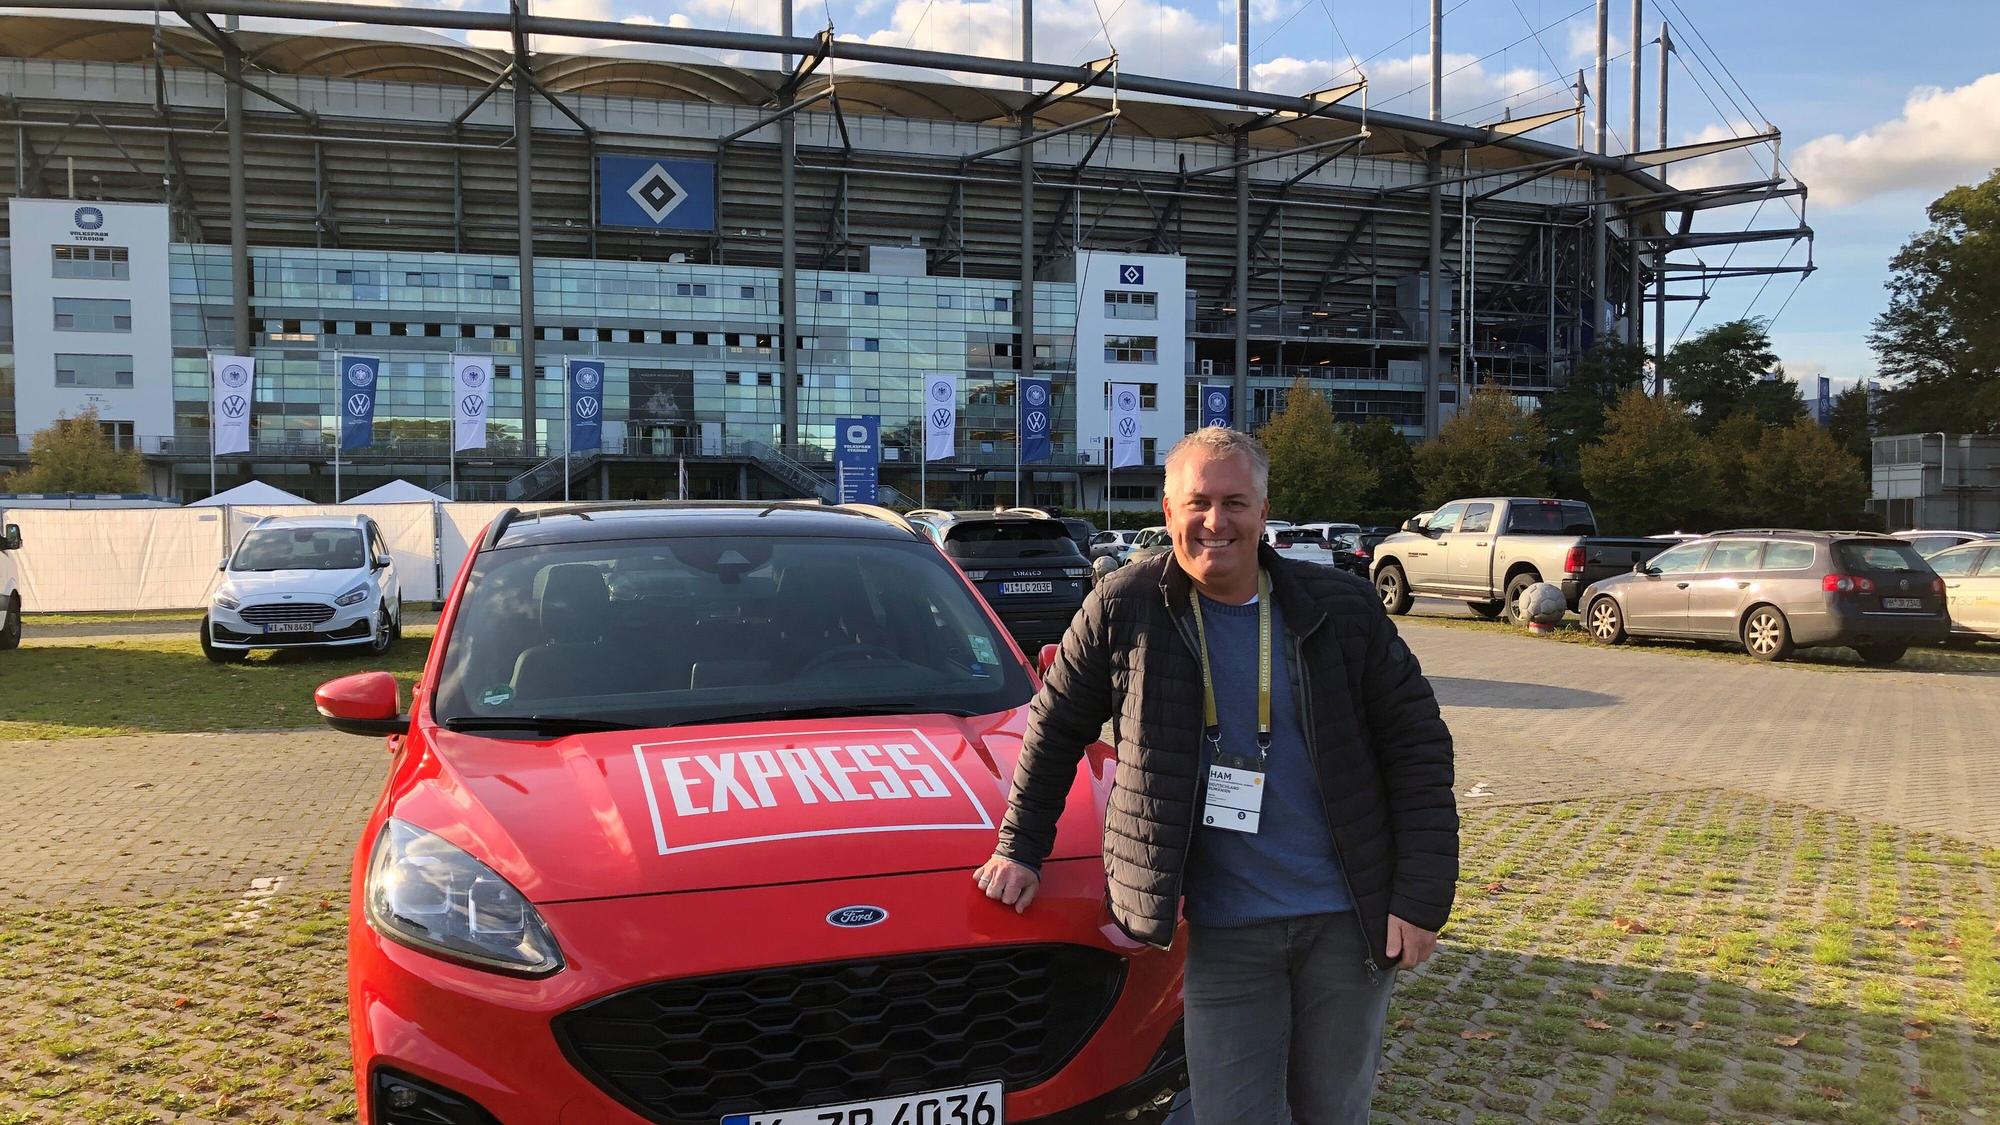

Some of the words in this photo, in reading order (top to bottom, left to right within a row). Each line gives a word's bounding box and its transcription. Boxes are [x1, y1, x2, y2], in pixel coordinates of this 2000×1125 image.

[661, 744, 952, 817] EXPRESS
[1210, 770, 1231, 780] HAM
[841, 910, 873, 923] Ford
[890, 1091, 995, 1125] 4036
